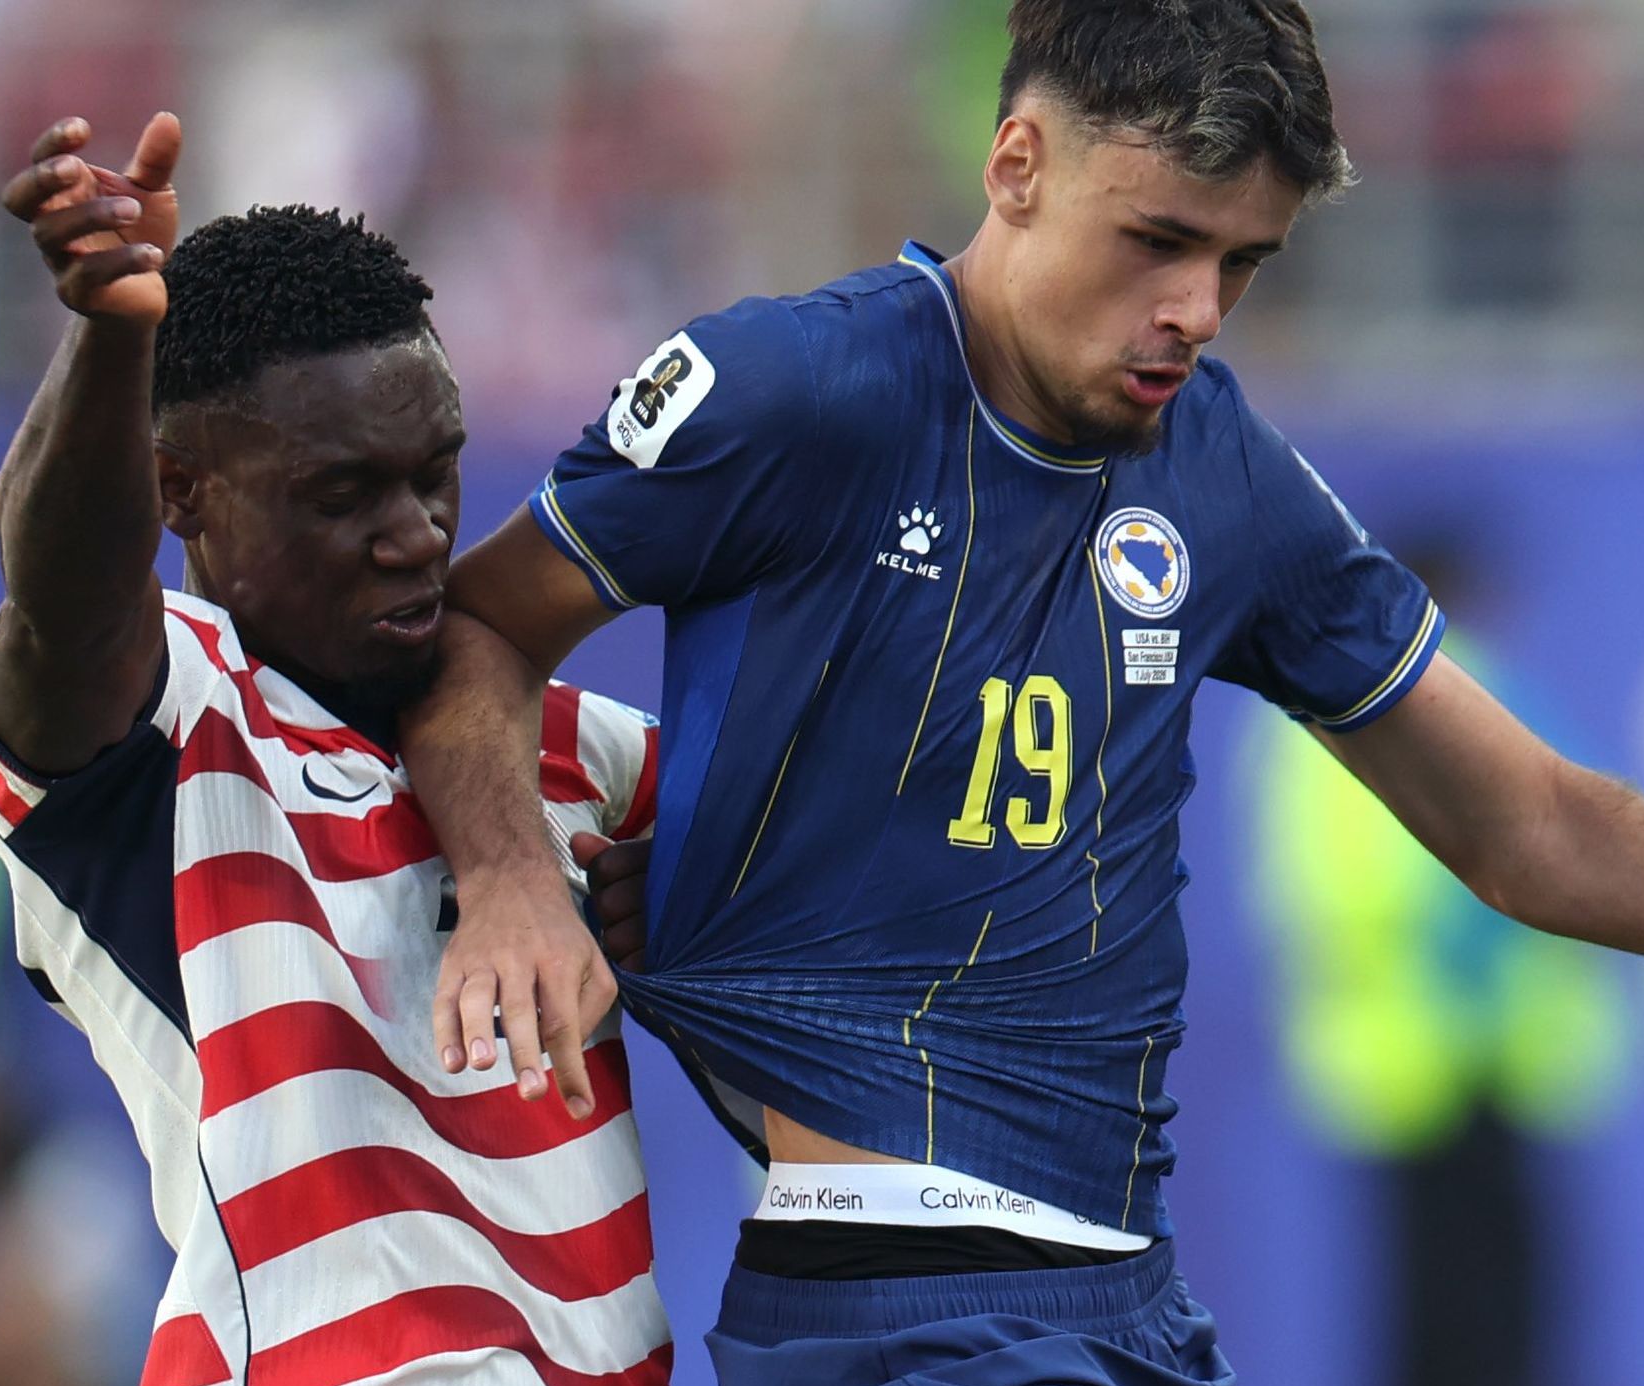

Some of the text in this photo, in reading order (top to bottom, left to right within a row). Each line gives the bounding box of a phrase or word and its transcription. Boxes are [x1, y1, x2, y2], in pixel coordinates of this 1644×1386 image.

[876, 551, 943, 580] KELME
[1135, 633, 1150, 644] USA
[1128, 651, 1139, 662] San
[1140, 669, 1151, 683] July
[947, 675, 1073, 849] 19
[770, 1184, 863, 1210] Calvin Klein
[920, 1186, 1036, 1216] Calvin Klein
